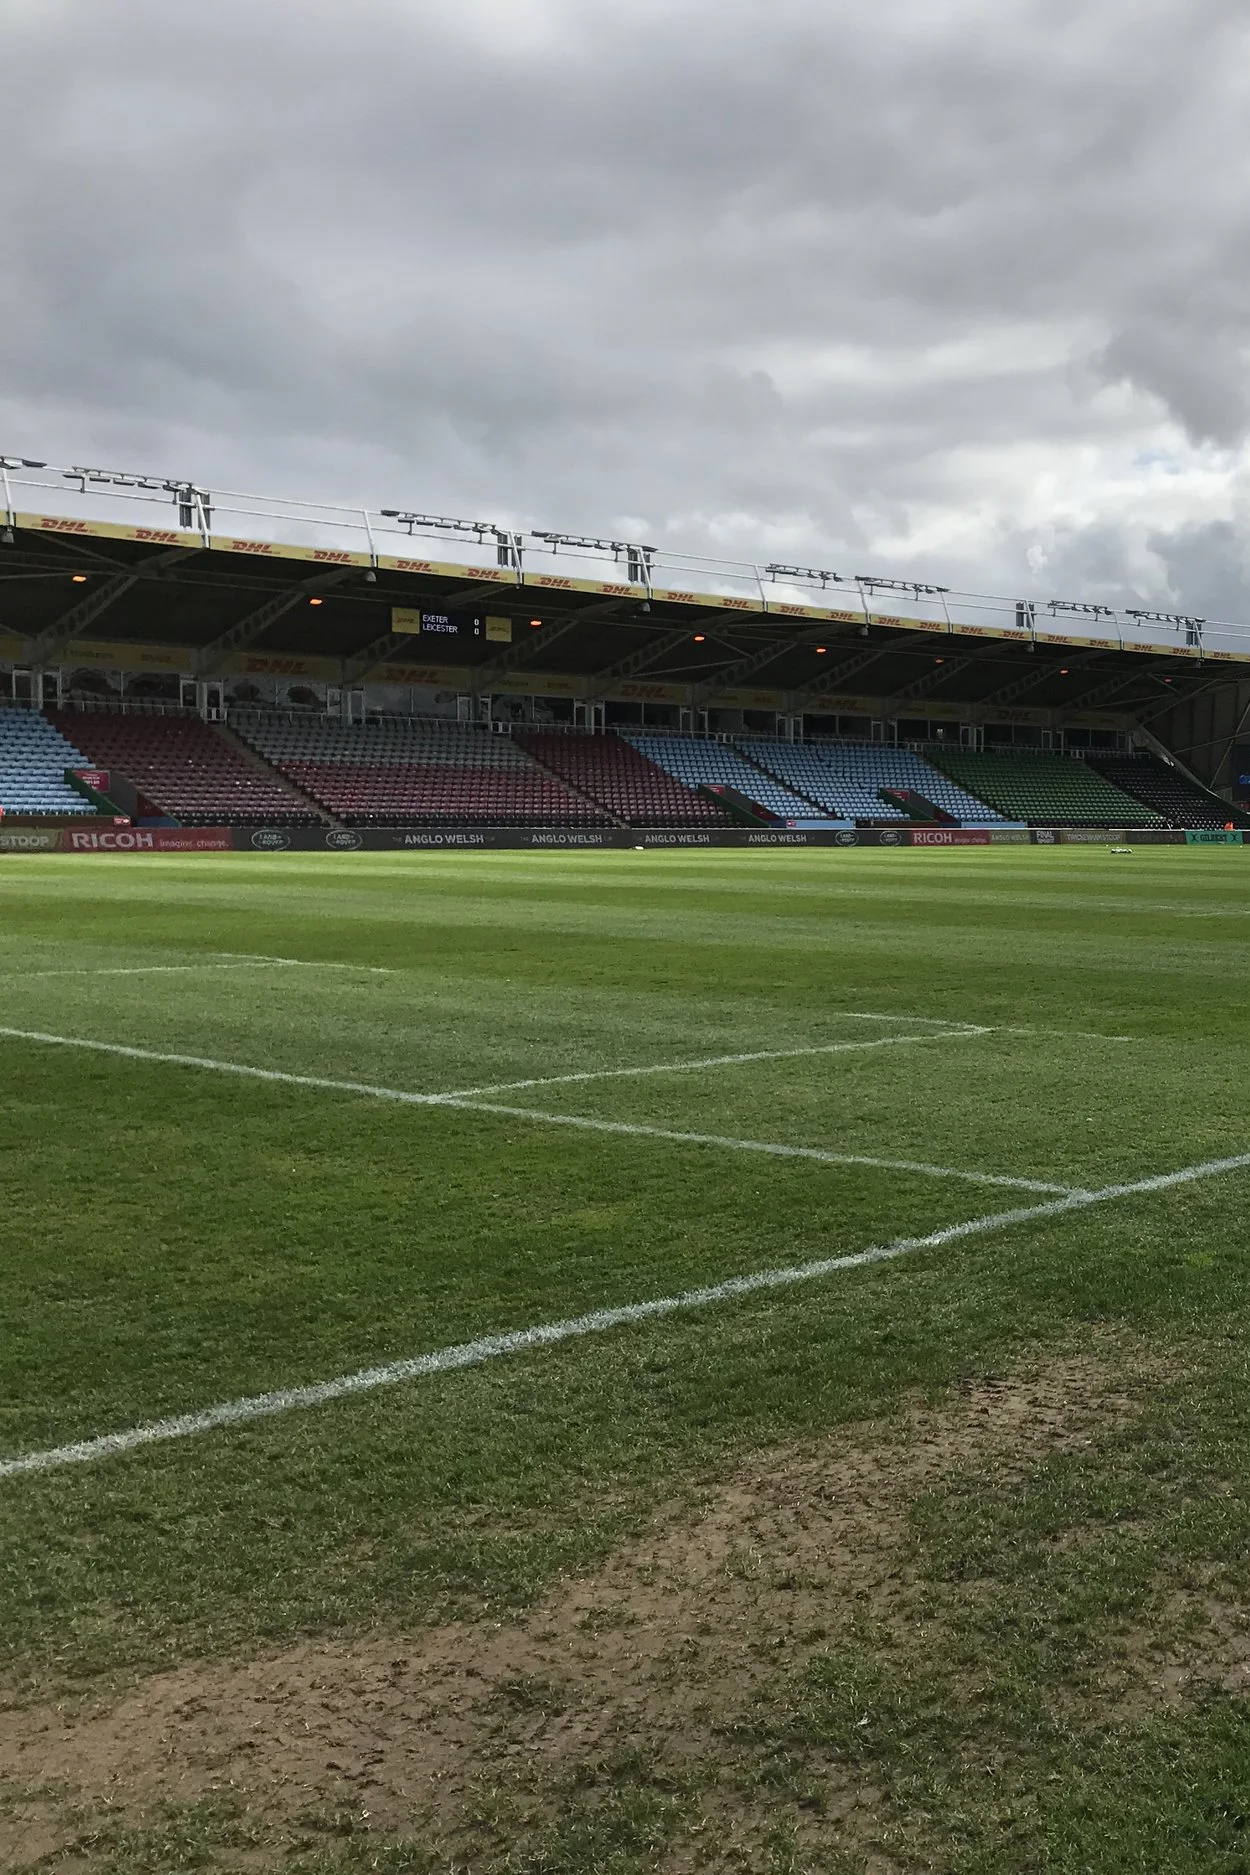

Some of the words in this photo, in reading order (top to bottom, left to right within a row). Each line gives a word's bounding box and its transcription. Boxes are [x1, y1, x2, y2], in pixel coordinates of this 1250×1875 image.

[41, 518, 88, 532] DHL
[135, 529, 180, 543] DHL
[232, 541, 273, 554] DHL
[313, 550, 352, 563] DHL
[396, 560, 432, 572] DHL
[467, 568, 502, 580] DHL
[539, 577, 571, 588] DHL
[602, 584, 633, 596] DHL
[667, 592, 696, 603] DHL
[722, 598, 750, 610] DHL
[780, 605, 806, 616] DHL
[830, 611, 854, 621] DHL
[422, 614, 448, 624] EXETER
[878, 616, 901, 626] DHL
[422, 623, 459, 633] LEICESTER
[919, 621, 941, 631] DHL
[960, 626, 984, 635] DHL
[1002, 630, 1026, 639] DHL
[1047, 635, 1070, 643] DHL
[246, 658, 308, 676] DHL
[385, 667, 440, 685] DHL
[405, 834, 443, 844] ANGLO
[445, 834, 484, 844] WELSH
[531, 834, 566, 844] ANGLO
[567, 834, 603, 844] WELSH
[645, 834, 676, 843] ANGLO
[678, 834, 710, 843] WELSH
[748, 834, 777, 843] ANGLO
[779, 834, 807, 843] WELSH
[913, 832, 952, 843] RICOH
[1036, 830, 1054, 838] FINAL
[0, 835, 49, 847] STOOP
[72, 832, 154, 848] RICOH
